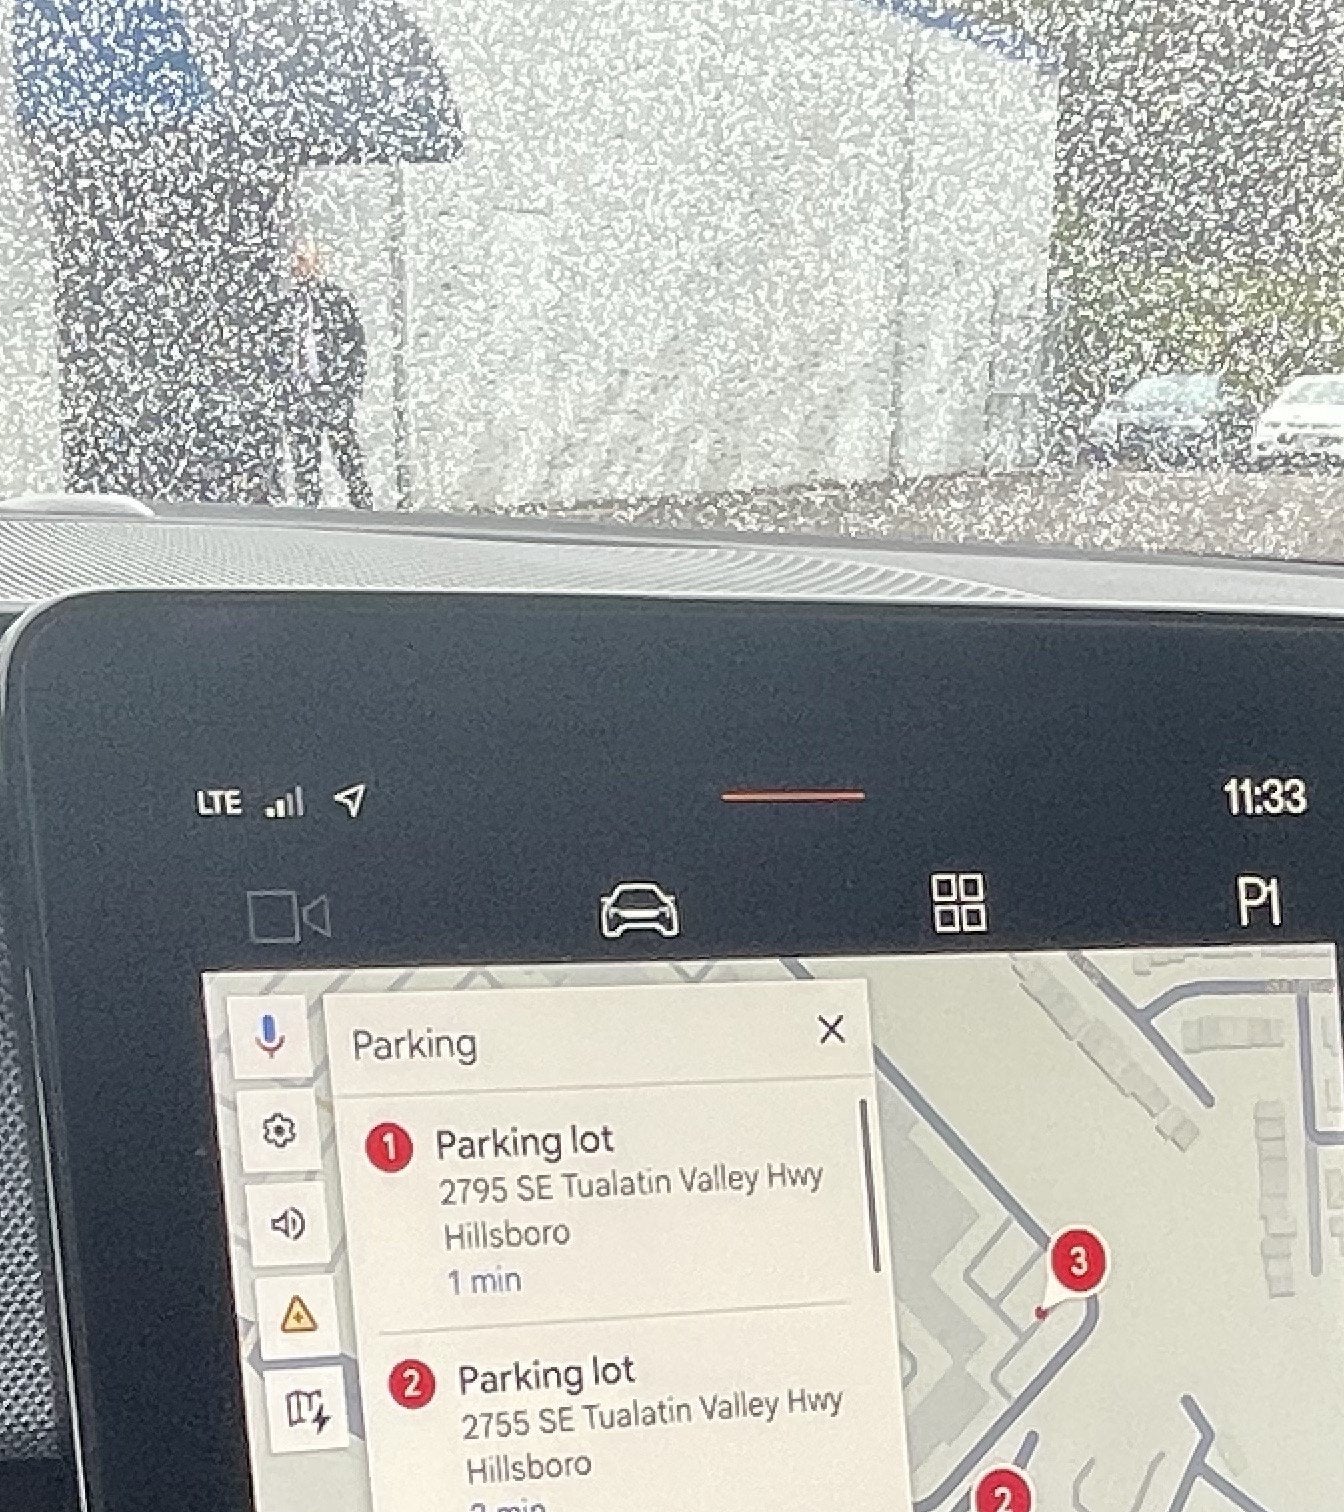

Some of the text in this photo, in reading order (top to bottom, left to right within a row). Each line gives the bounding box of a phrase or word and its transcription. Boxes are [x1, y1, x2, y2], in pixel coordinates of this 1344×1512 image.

[197, 790, 243, 815] LTE
[1224, 778, 1308, 815] 11:33
[351, 1027, 478, 1066] Parking
[382, 1132, 398, 1162] 1
[436, 1123, 616, 1163] Parking lot
[439, 1162, 824, 1206] 2795 SE Tualatin Valley Hwy
[444, 1221, 571, 1251] Hillsboro
[1070, 1246, 1090, 1276] 3
[448, 1266, 522, 1295] 1 min
[403, 1368, 422, 1398] 2
[458, 1356, 636, 1395] Parking lot
[462, 1388, 844, 1440] 2755 SE Tualatin Valley Hwy
[467, 1455, 592, 1485] Hillsboro
